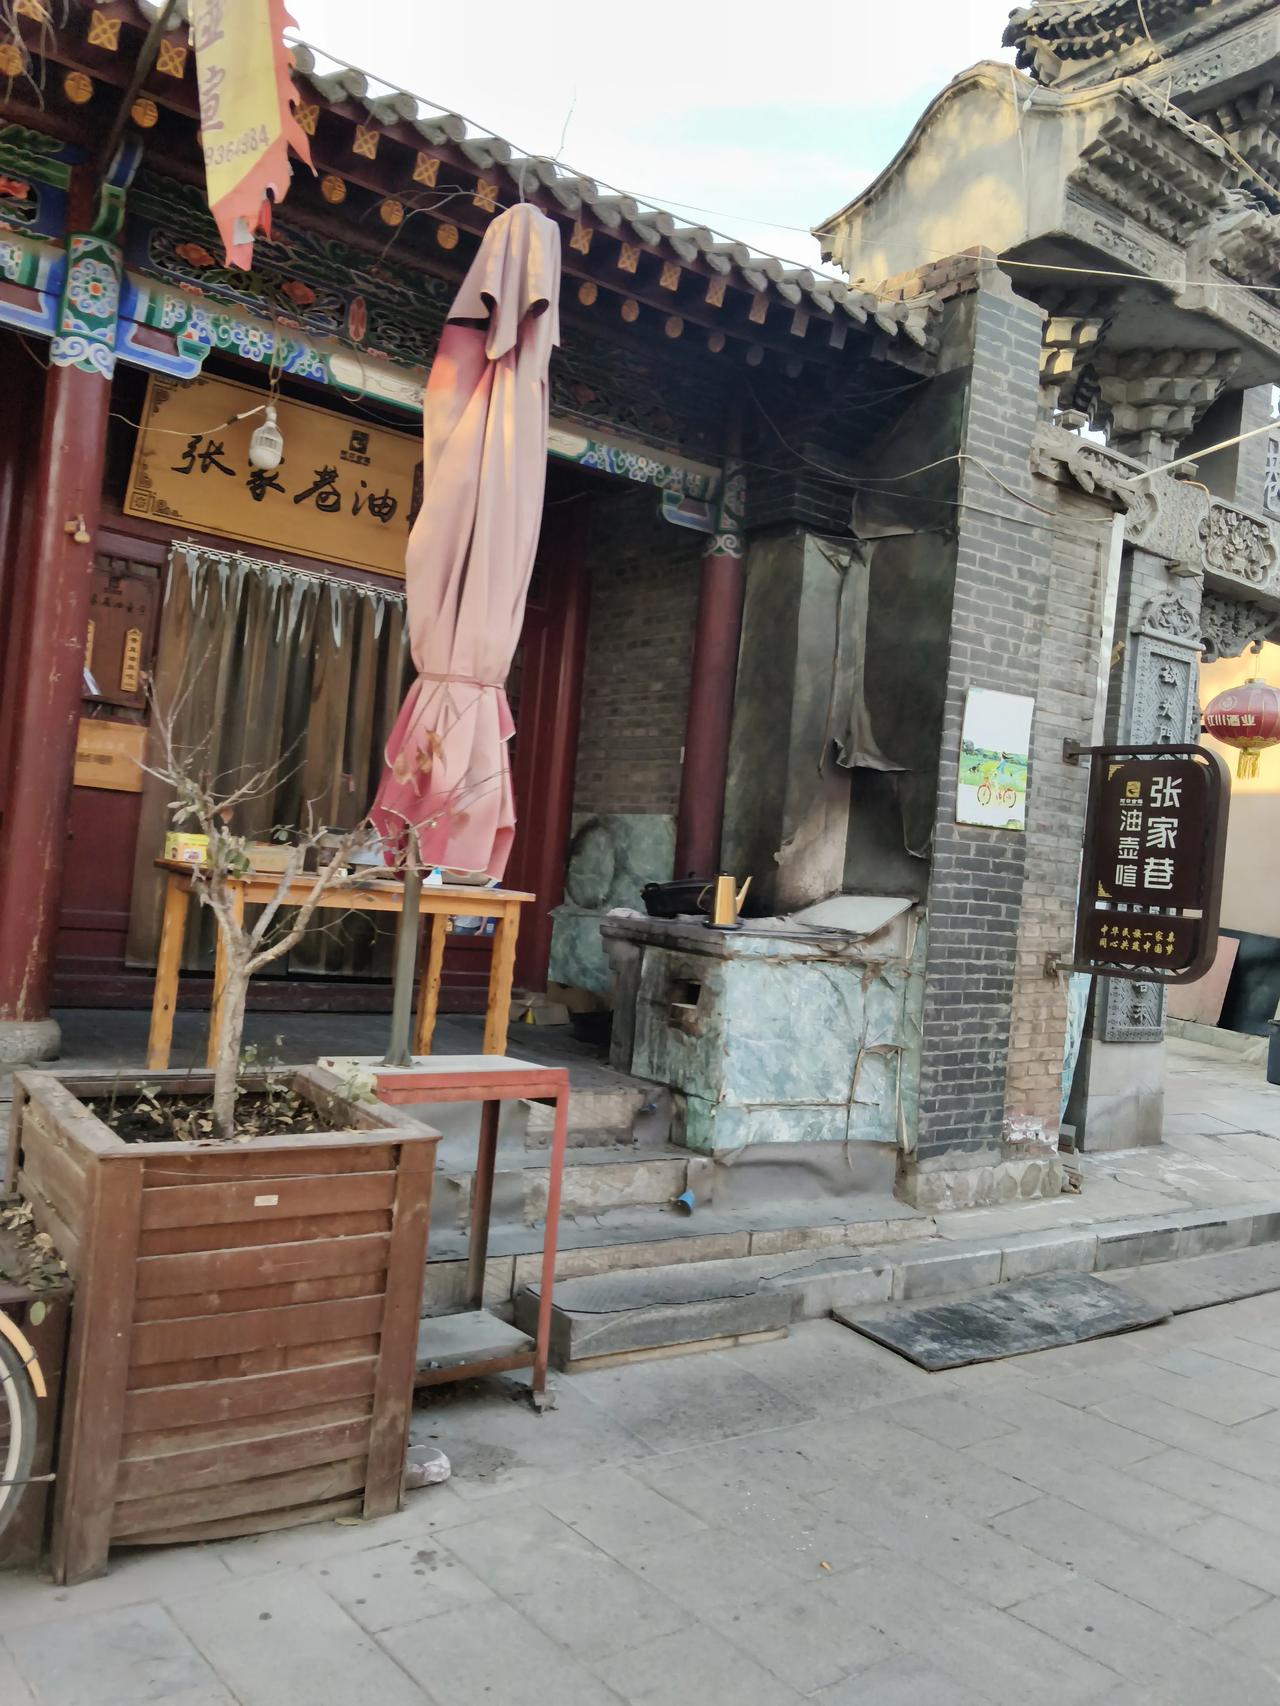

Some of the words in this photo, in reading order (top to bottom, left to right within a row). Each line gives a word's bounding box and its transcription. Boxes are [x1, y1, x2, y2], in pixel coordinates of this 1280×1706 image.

[171, 434, 412, 526] 张家巷油
[1115, 809, 1142, 887] 油壶喧
[1143, 776, 1182, 890] 张家巷
